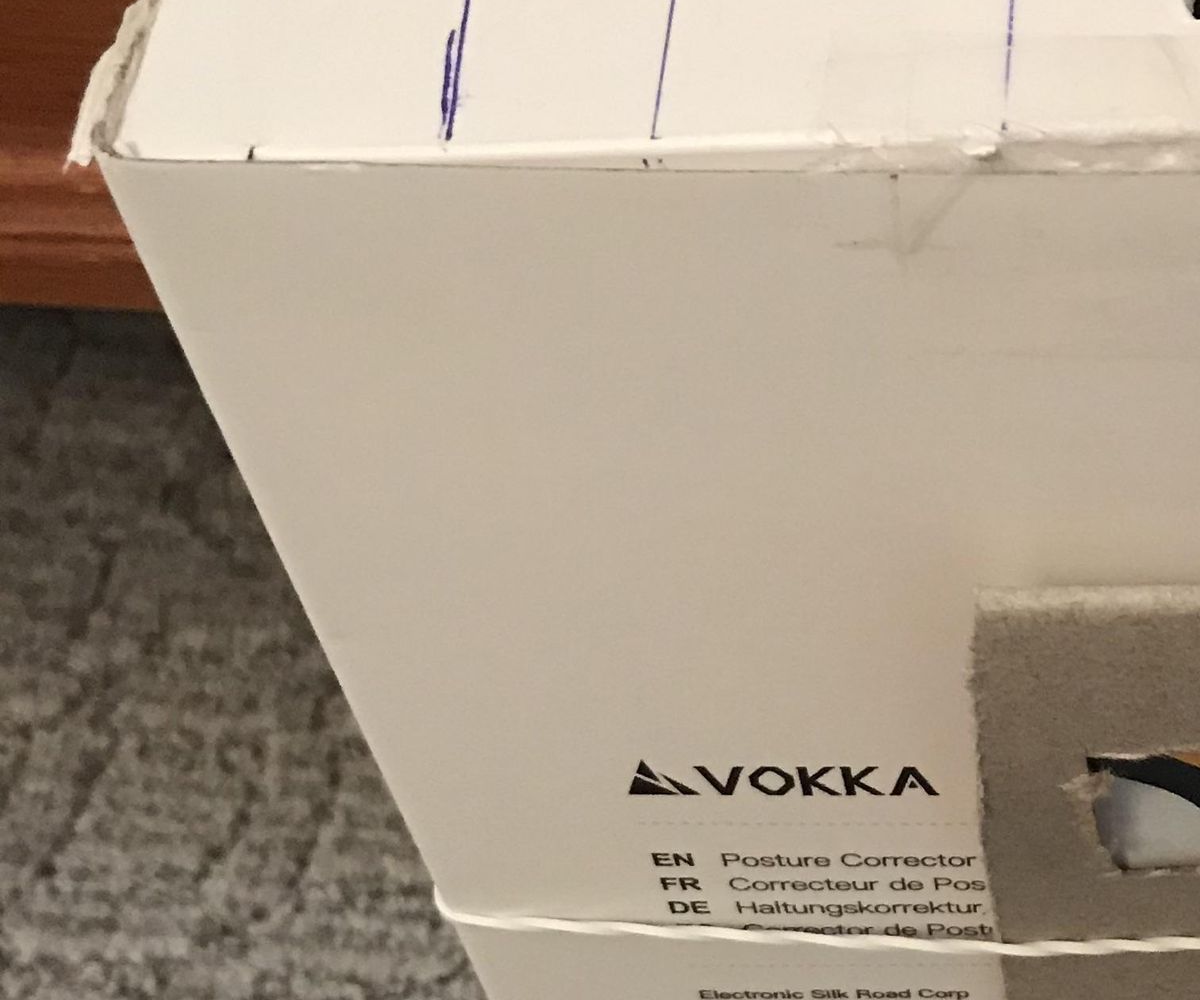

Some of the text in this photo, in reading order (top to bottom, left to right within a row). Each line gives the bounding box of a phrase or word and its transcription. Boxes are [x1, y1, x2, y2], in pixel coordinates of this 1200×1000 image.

[693, 765, 940, 797] VOKKA
[651, 852, 977, 868] EN Posture Corrector
[660, 876, 702, 891] FR
[728, 876, 879, 892] Correcteur
[889, 877, 925, 891] de
[668, 900, 711, 915] DE
[883, 923, 918, 937] de
[698, 988, 970, 1000] Electronic Silk Road Corp
